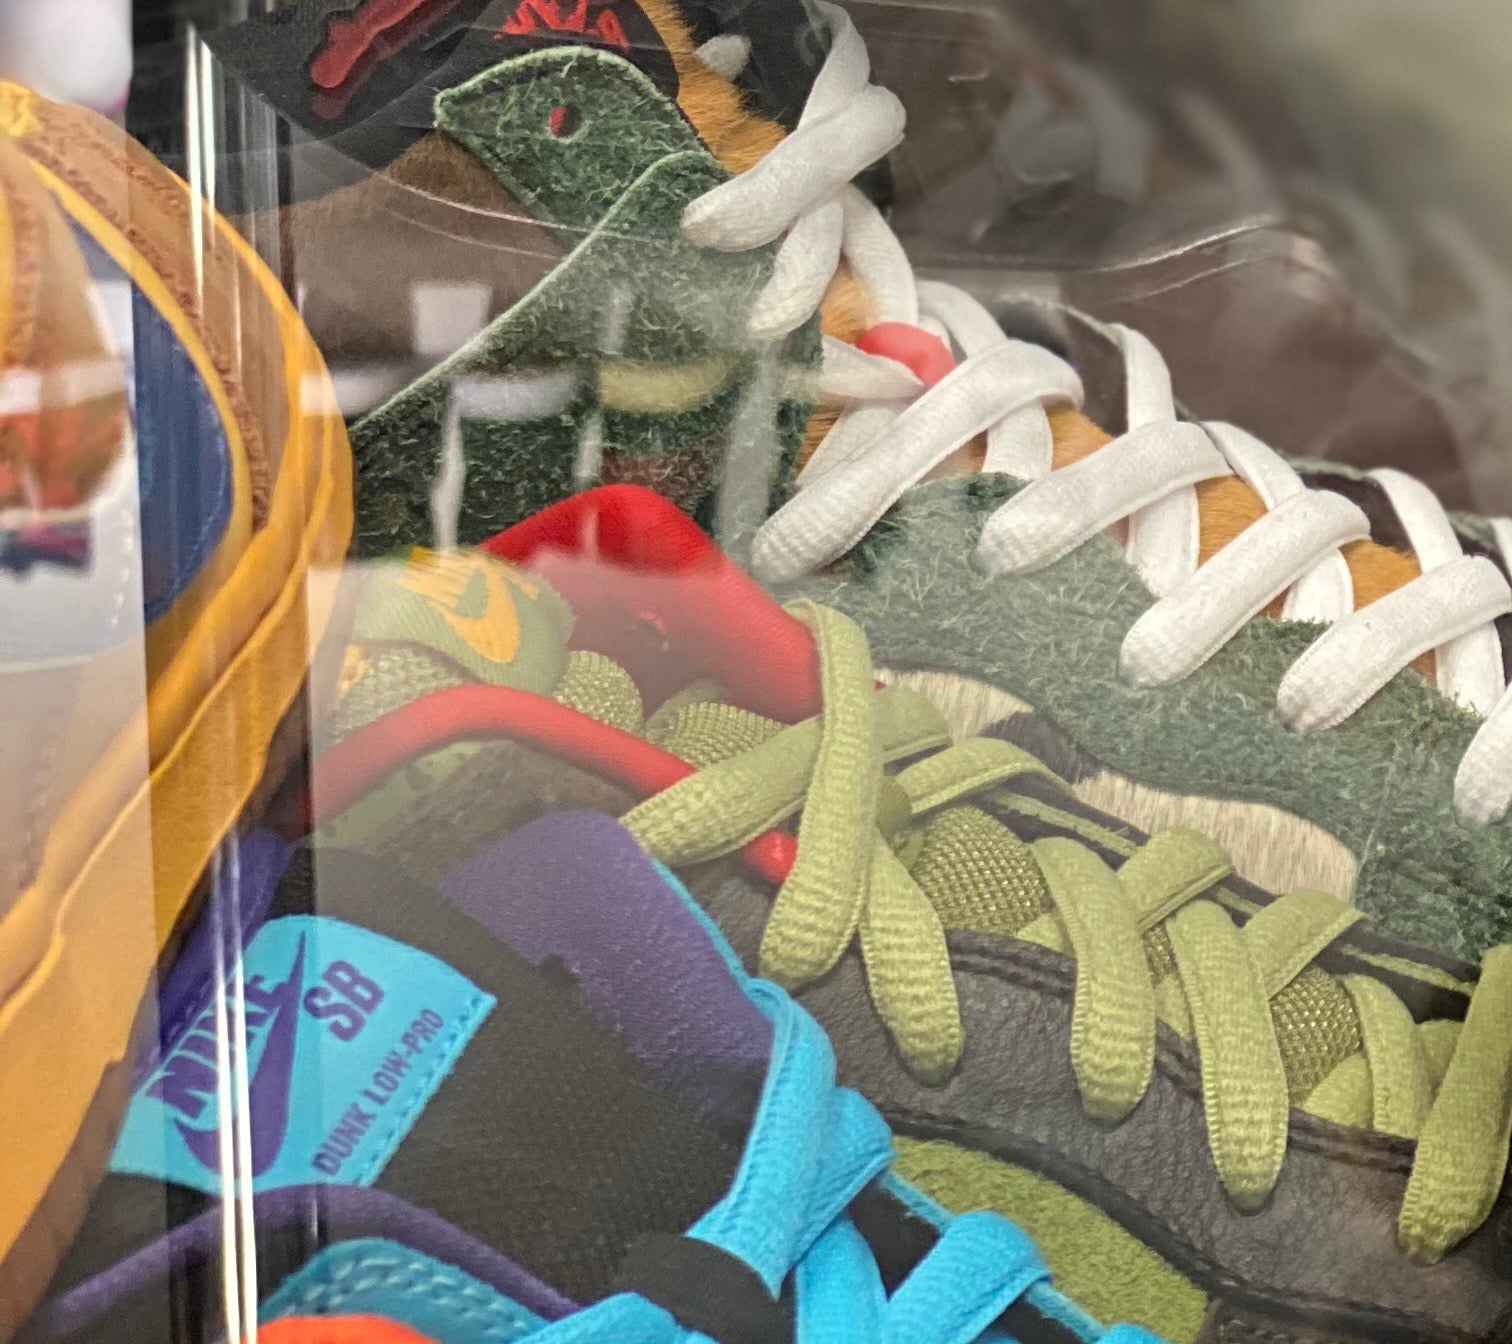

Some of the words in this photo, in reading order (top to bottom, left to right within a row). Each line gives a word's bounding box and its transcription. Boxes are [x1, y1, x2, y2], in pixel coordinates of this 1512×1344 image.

[303, 960, 385, 1043] SB
[311, 1109, 375, 1177] DUNK
[363, 1007, 446, 1107] LOW-PRO
